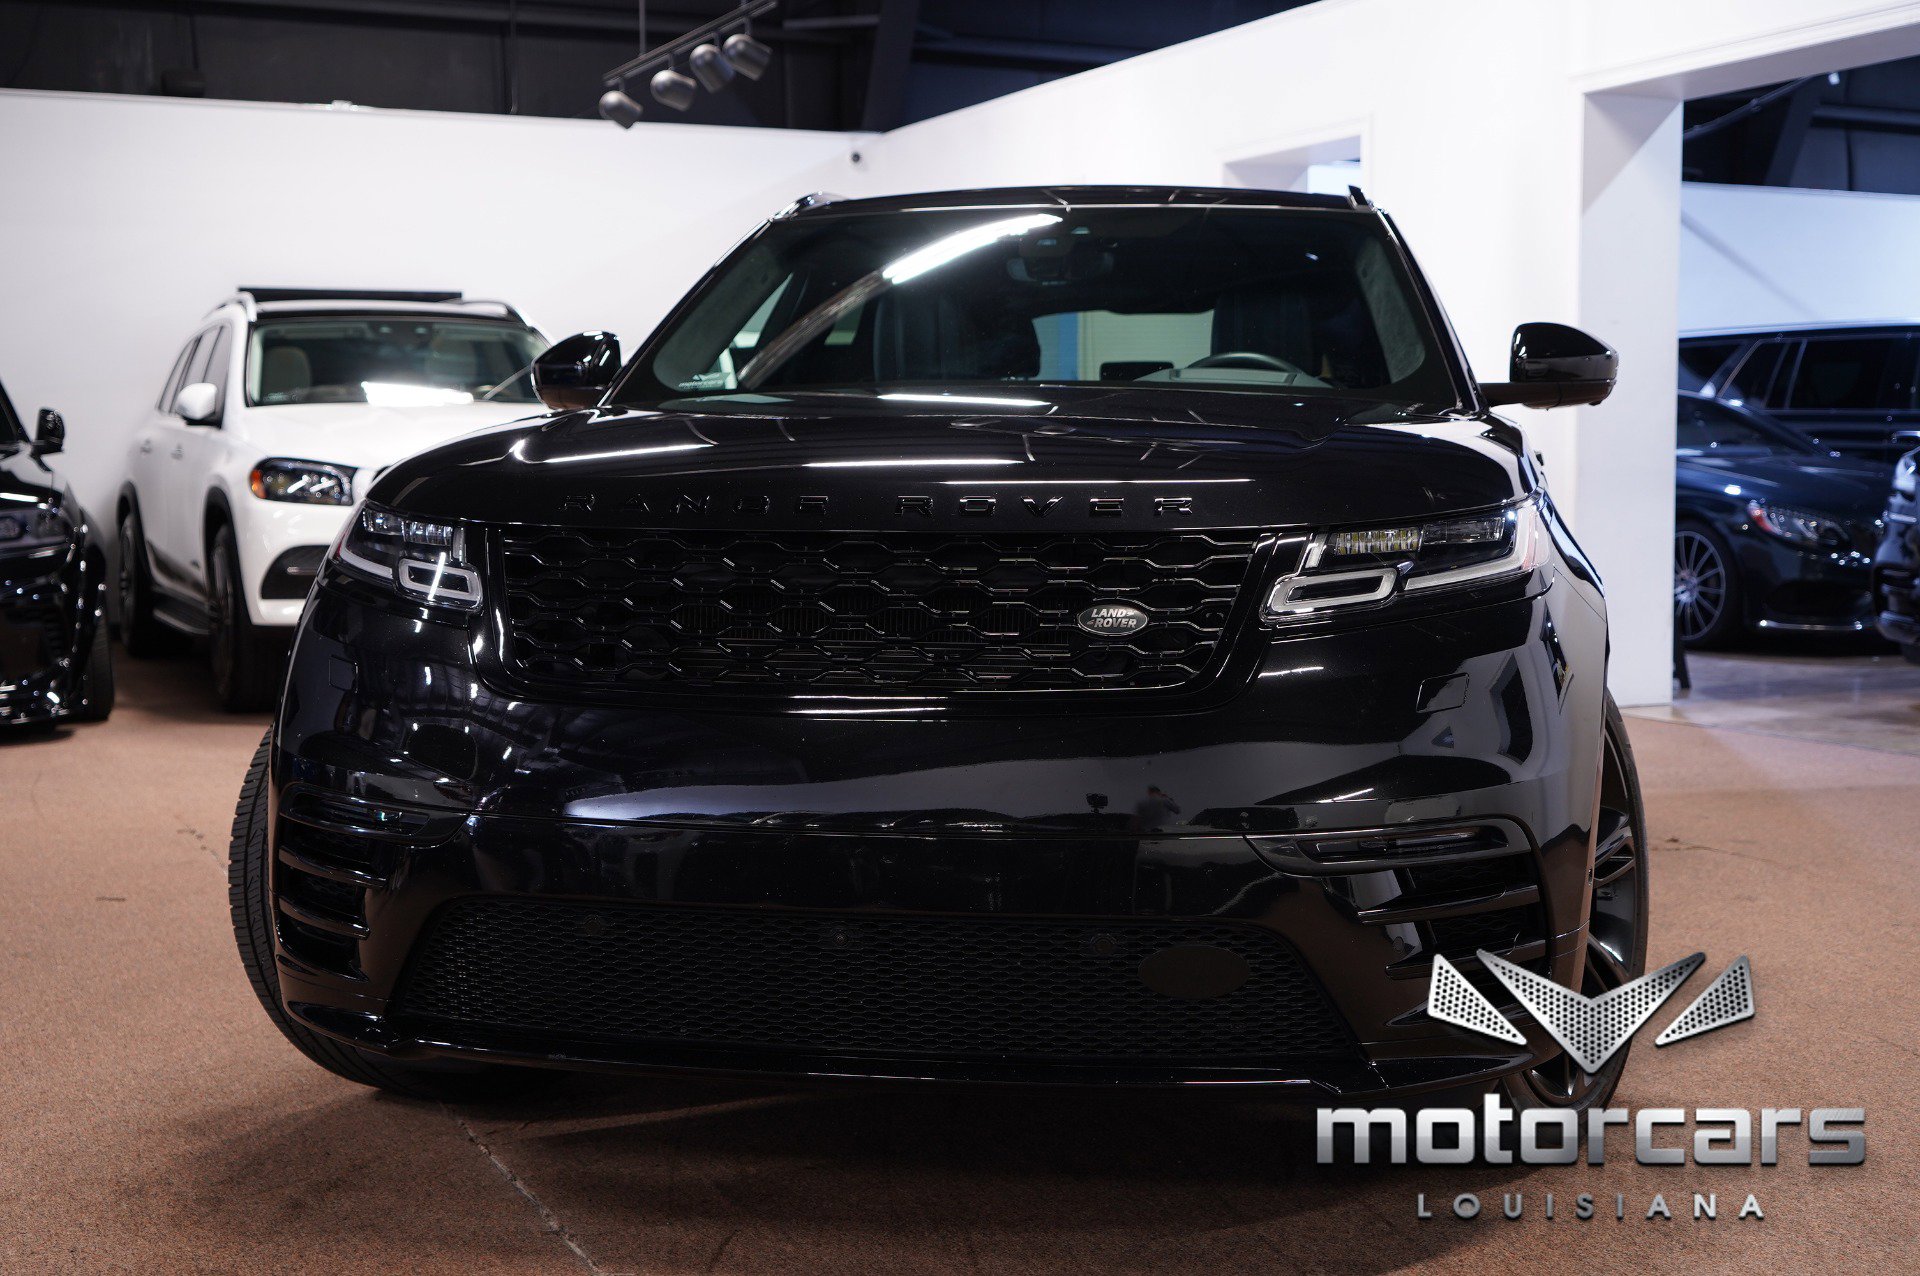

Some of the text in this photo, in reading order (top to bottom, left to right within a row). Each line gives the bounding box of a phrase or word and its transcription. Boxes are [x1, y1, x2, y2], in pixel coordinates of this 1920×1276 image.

[894, 494, 1194, 516] ROVER
[1091, 608, 1127, 618] LAND
[1094, 618, 1137, 628] ROVER
